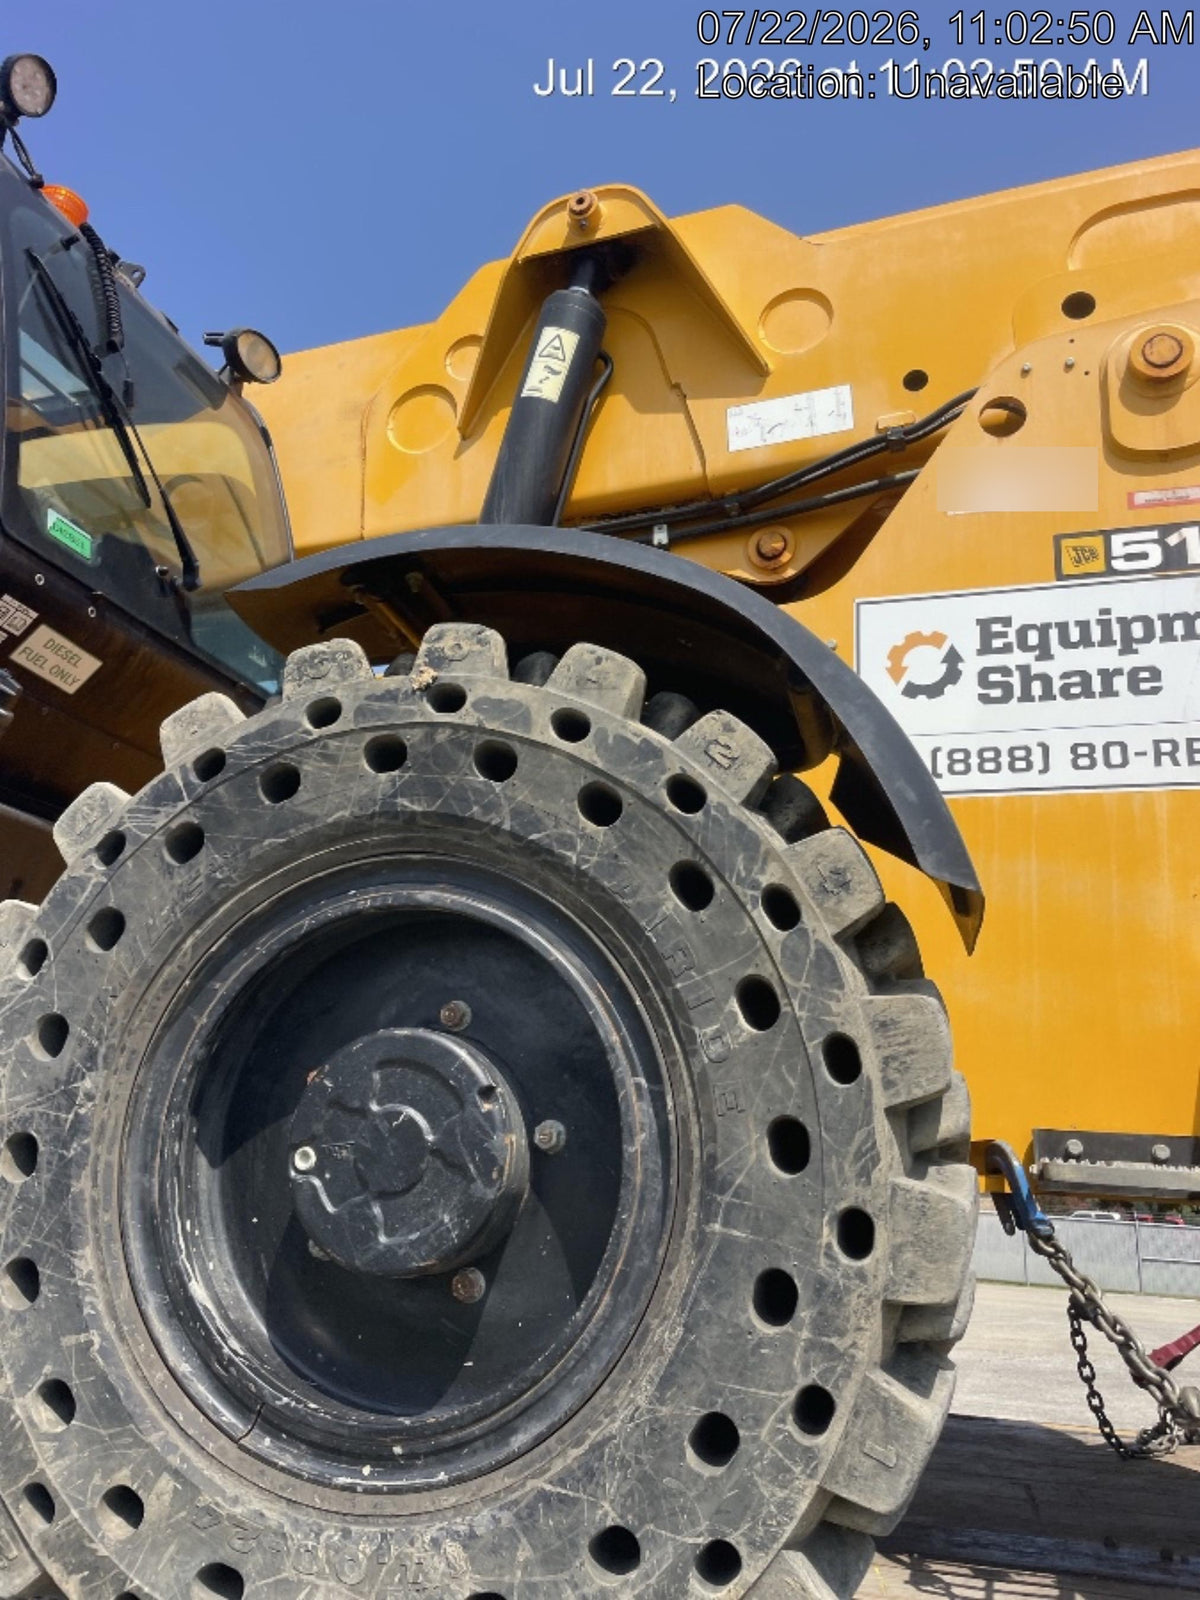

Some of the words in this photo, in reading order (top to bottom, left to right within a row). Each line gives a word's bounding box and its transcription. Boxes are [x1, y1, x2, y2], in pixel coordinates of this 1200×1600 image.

[1065, 545, 1100, 567] JCB
[18, 646, 48, 669] FUEL
[49, 664, 80, 686] ONLY
[43, 638, 82, 668] DIESEL
[976, 664, 1163, 705] Share
[930, 741, 1050, 779] (888)
